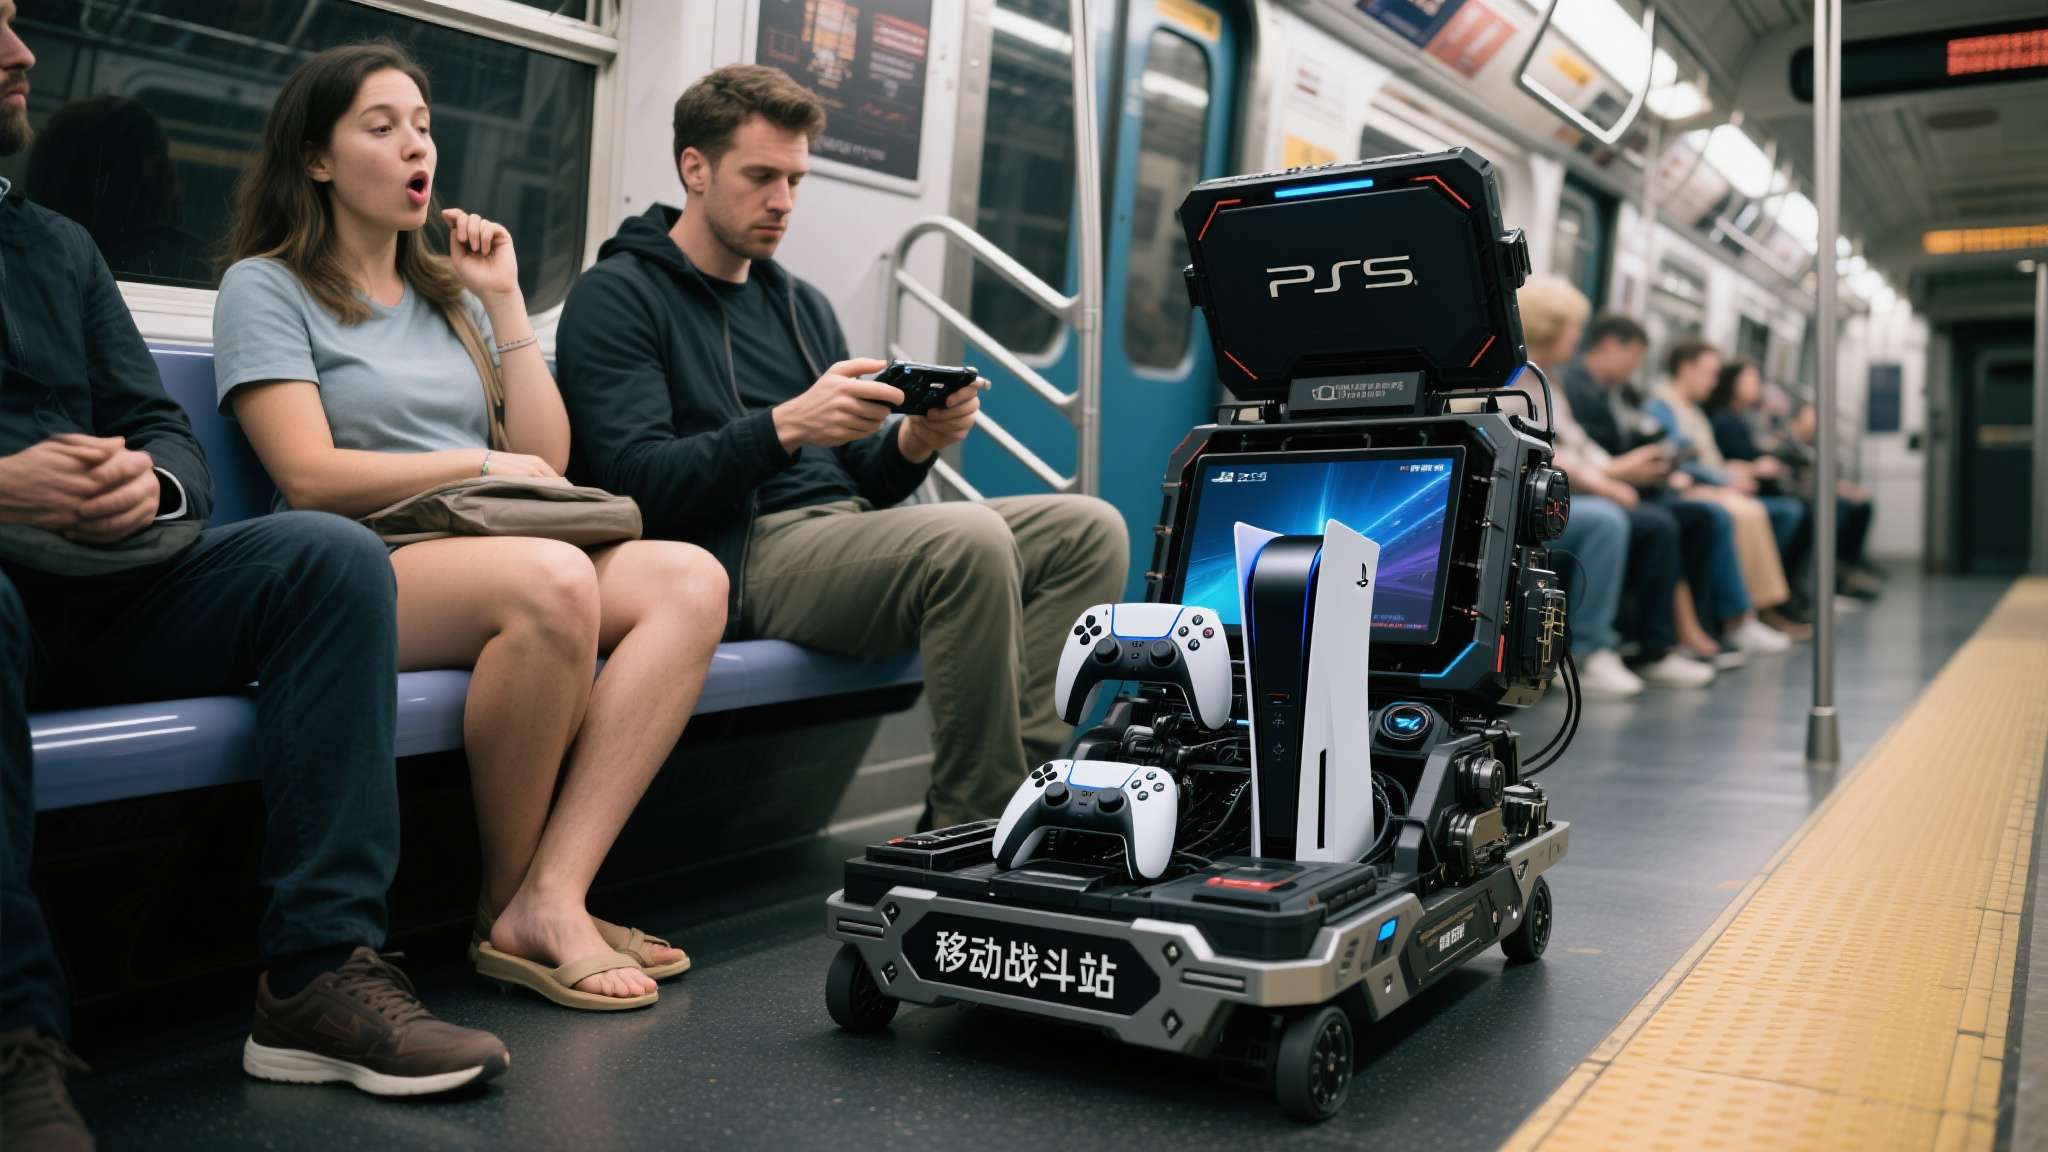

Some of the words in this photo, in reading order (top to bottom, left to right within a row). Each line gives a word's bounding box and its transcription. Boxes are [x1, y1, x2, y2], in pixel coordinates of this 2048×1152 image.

[935, 931, 1117, 999] 移动战斗站
